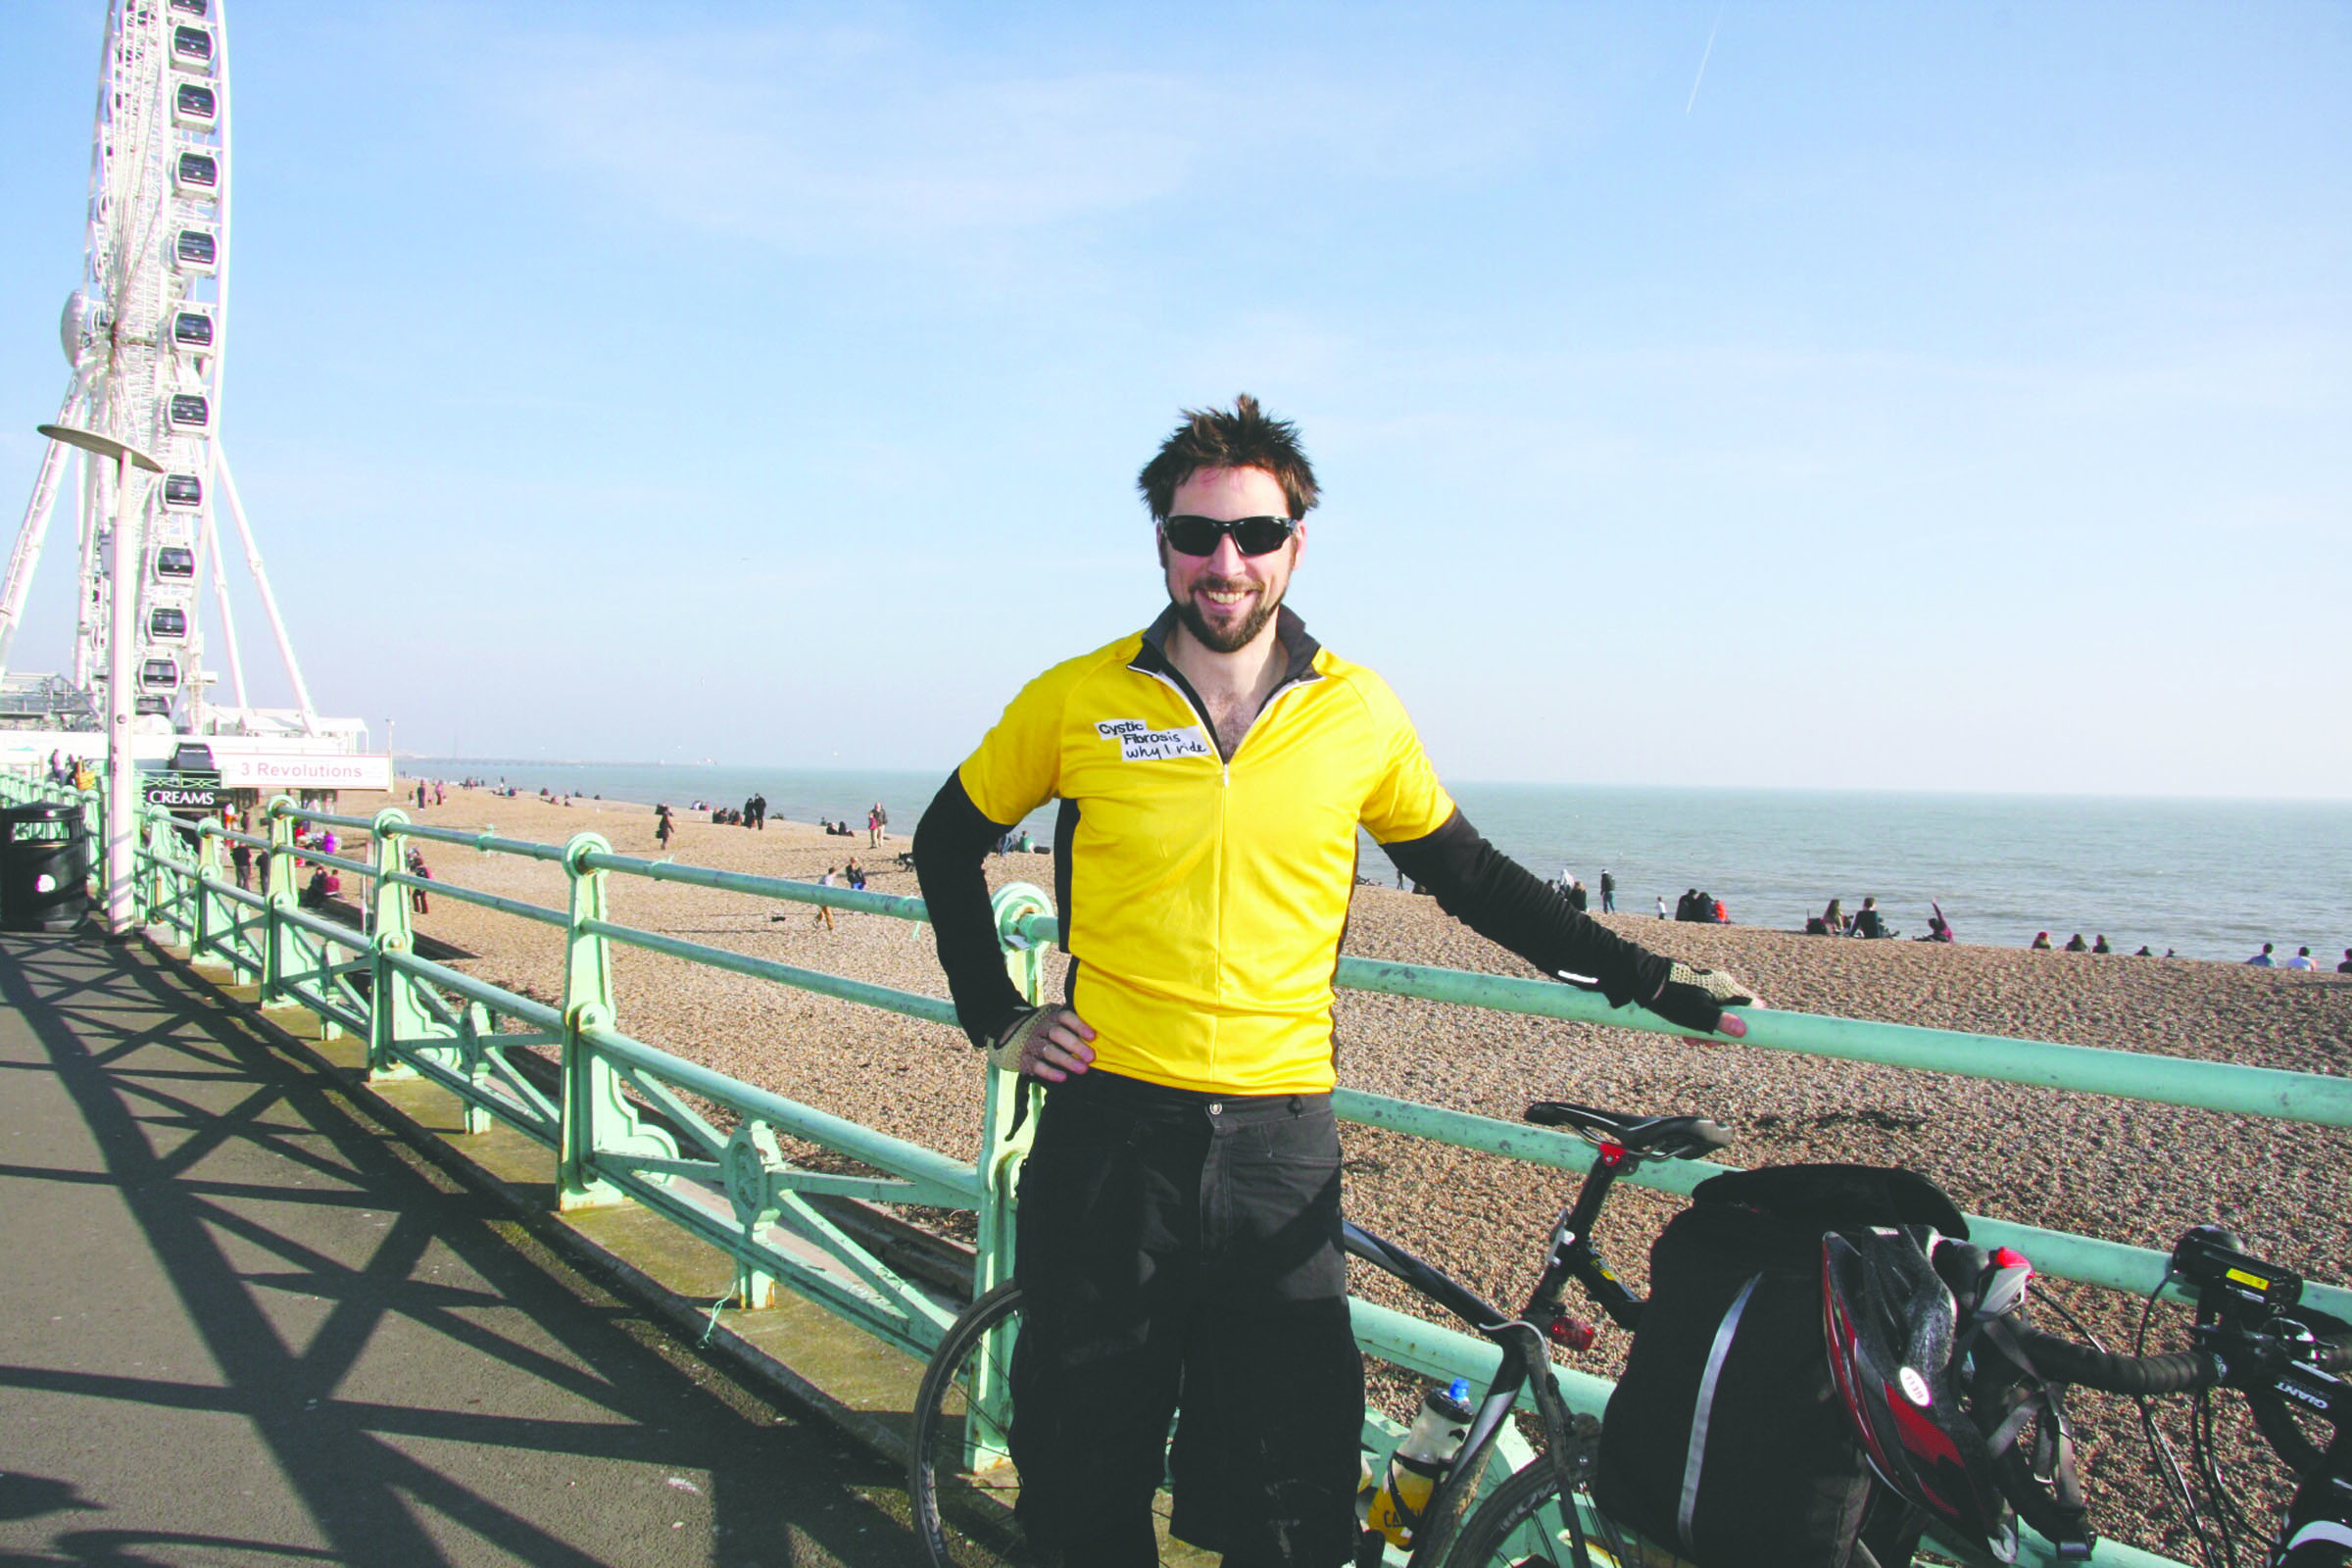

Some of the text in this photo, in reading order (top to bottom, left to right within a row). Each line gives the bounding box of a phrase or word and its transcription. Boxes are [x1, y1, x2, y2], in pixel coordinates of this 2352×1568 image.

[1098, 721, 1145, 735] Cystic
[1123, 732, 1181, 745] Fibrosis
[1125, 745, 1162, 760] why
[1177, 740, 1207, 754] ride
[241, 762, 363, 778] 3 Revolutions
[149, 790, 215, 805] CREAMS
[2274, 1381, 2329, 1409] GIANT
